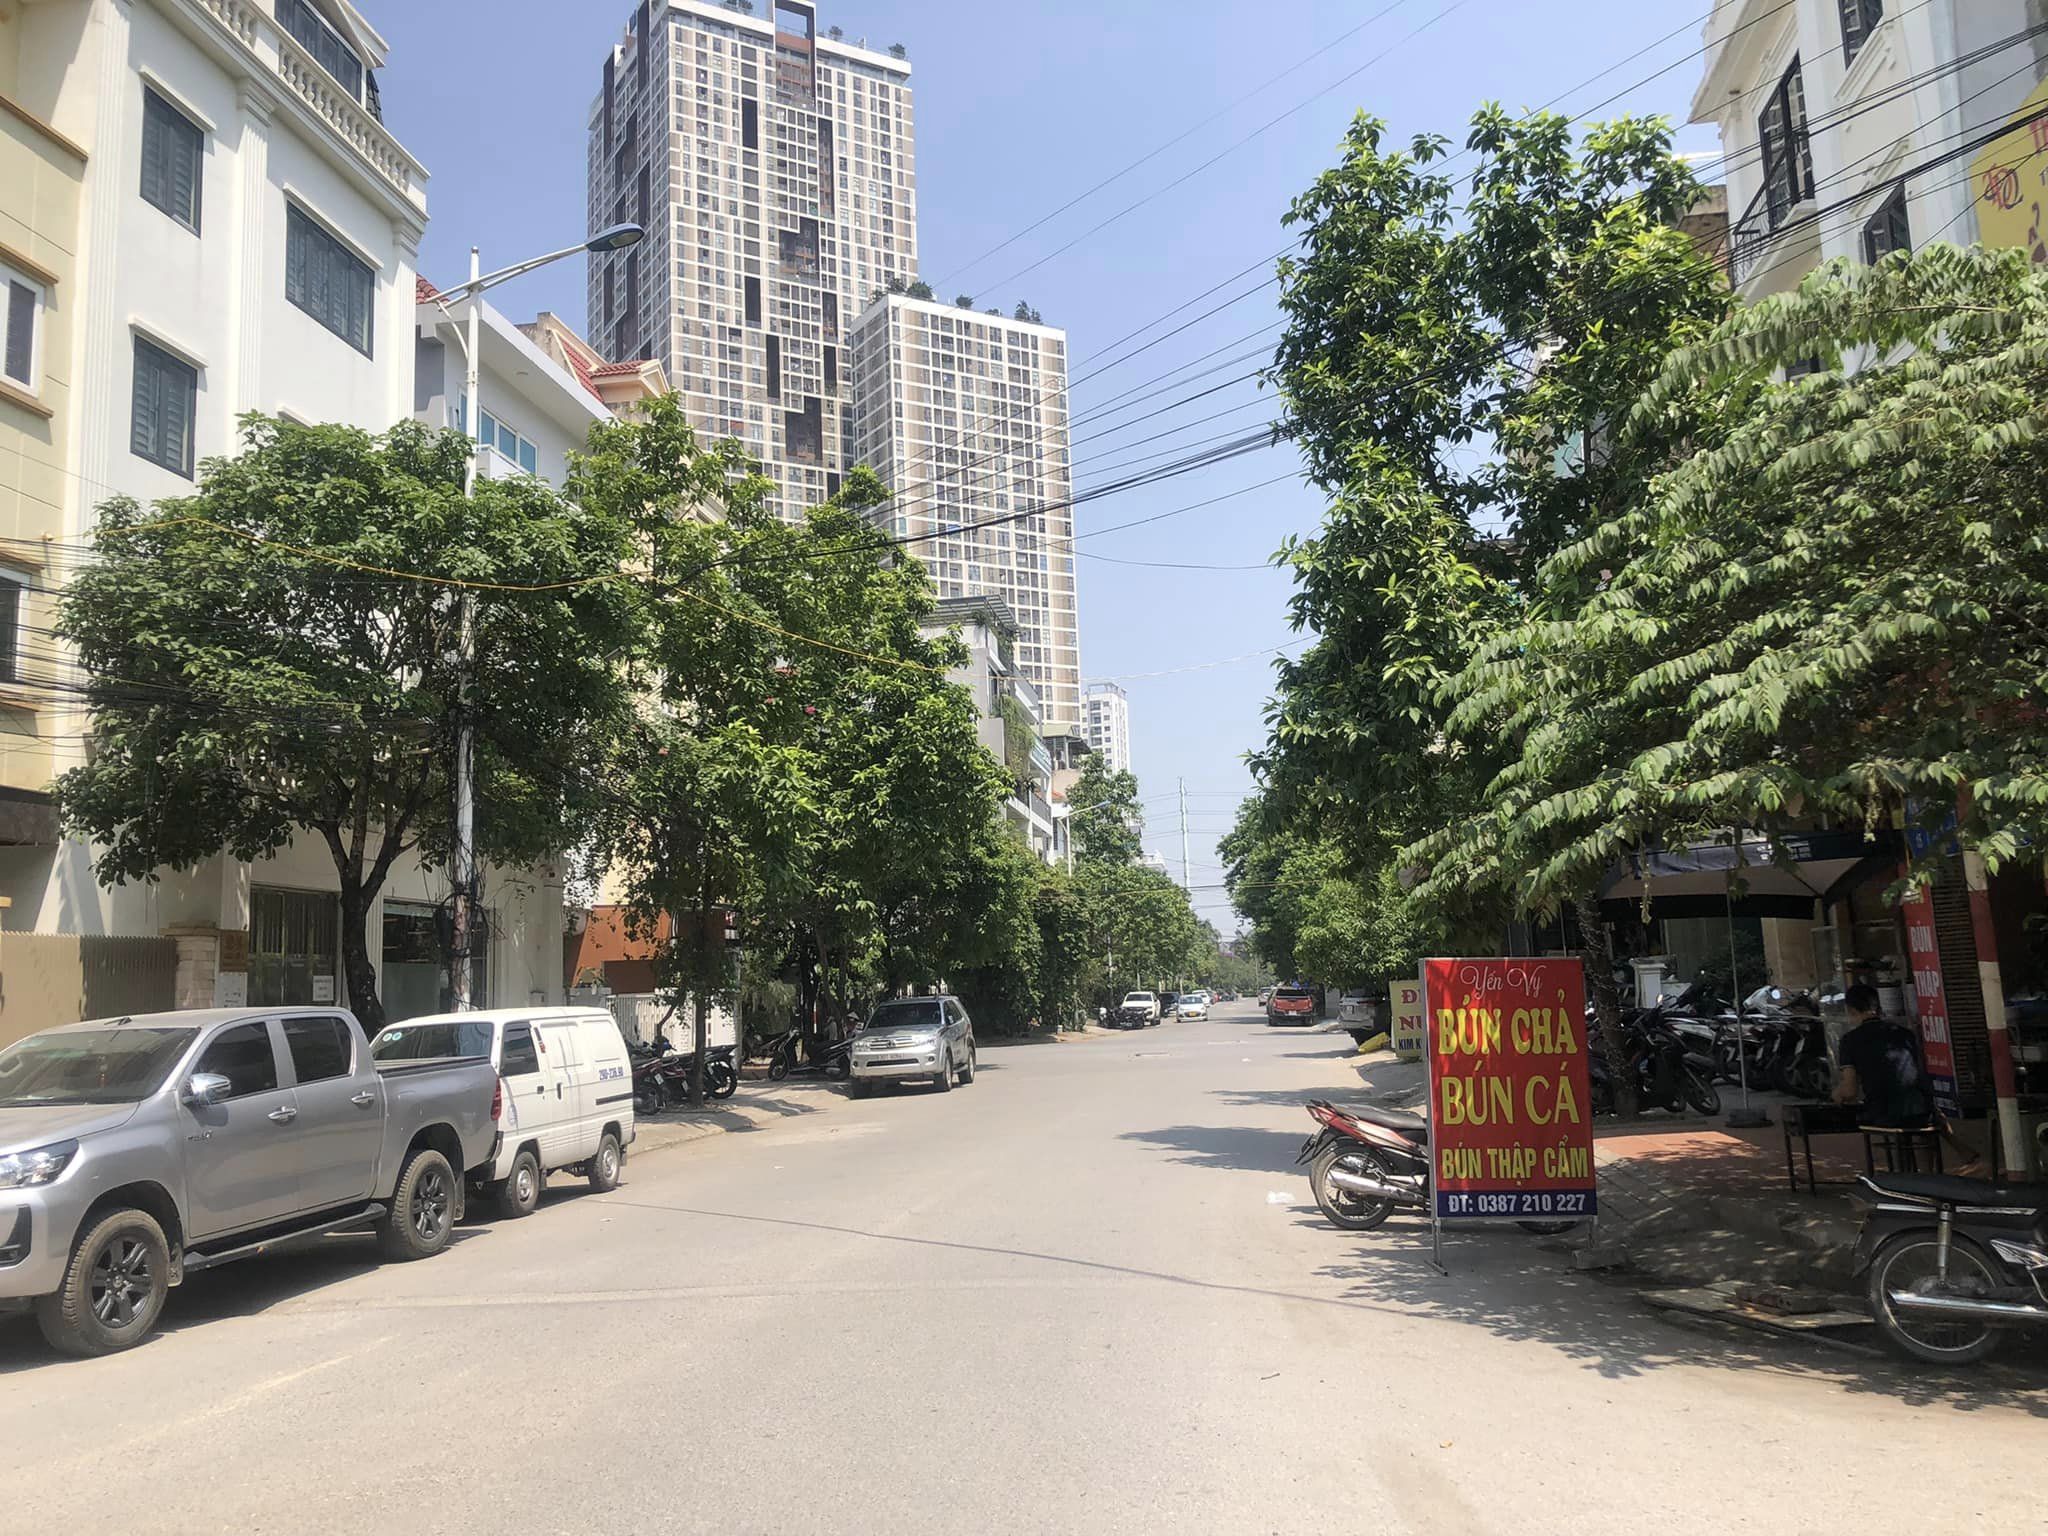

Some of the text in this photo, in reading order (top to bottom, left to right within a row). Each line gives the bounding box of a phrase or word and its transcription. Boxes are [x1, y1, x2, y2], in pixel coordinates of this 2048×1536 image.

[1460, 965, 1547, 1000] Yến Vy
[1436, 988, 1578, 1055] BÚN CHẢ
[1441, 1060, 1580, 1125] BÚN CÁ
[1442, 1134, 1589, 1186] BÚN THẬP CẨM
[1448, 1193, 1585, 1213] ĐT: 0387 210 227
